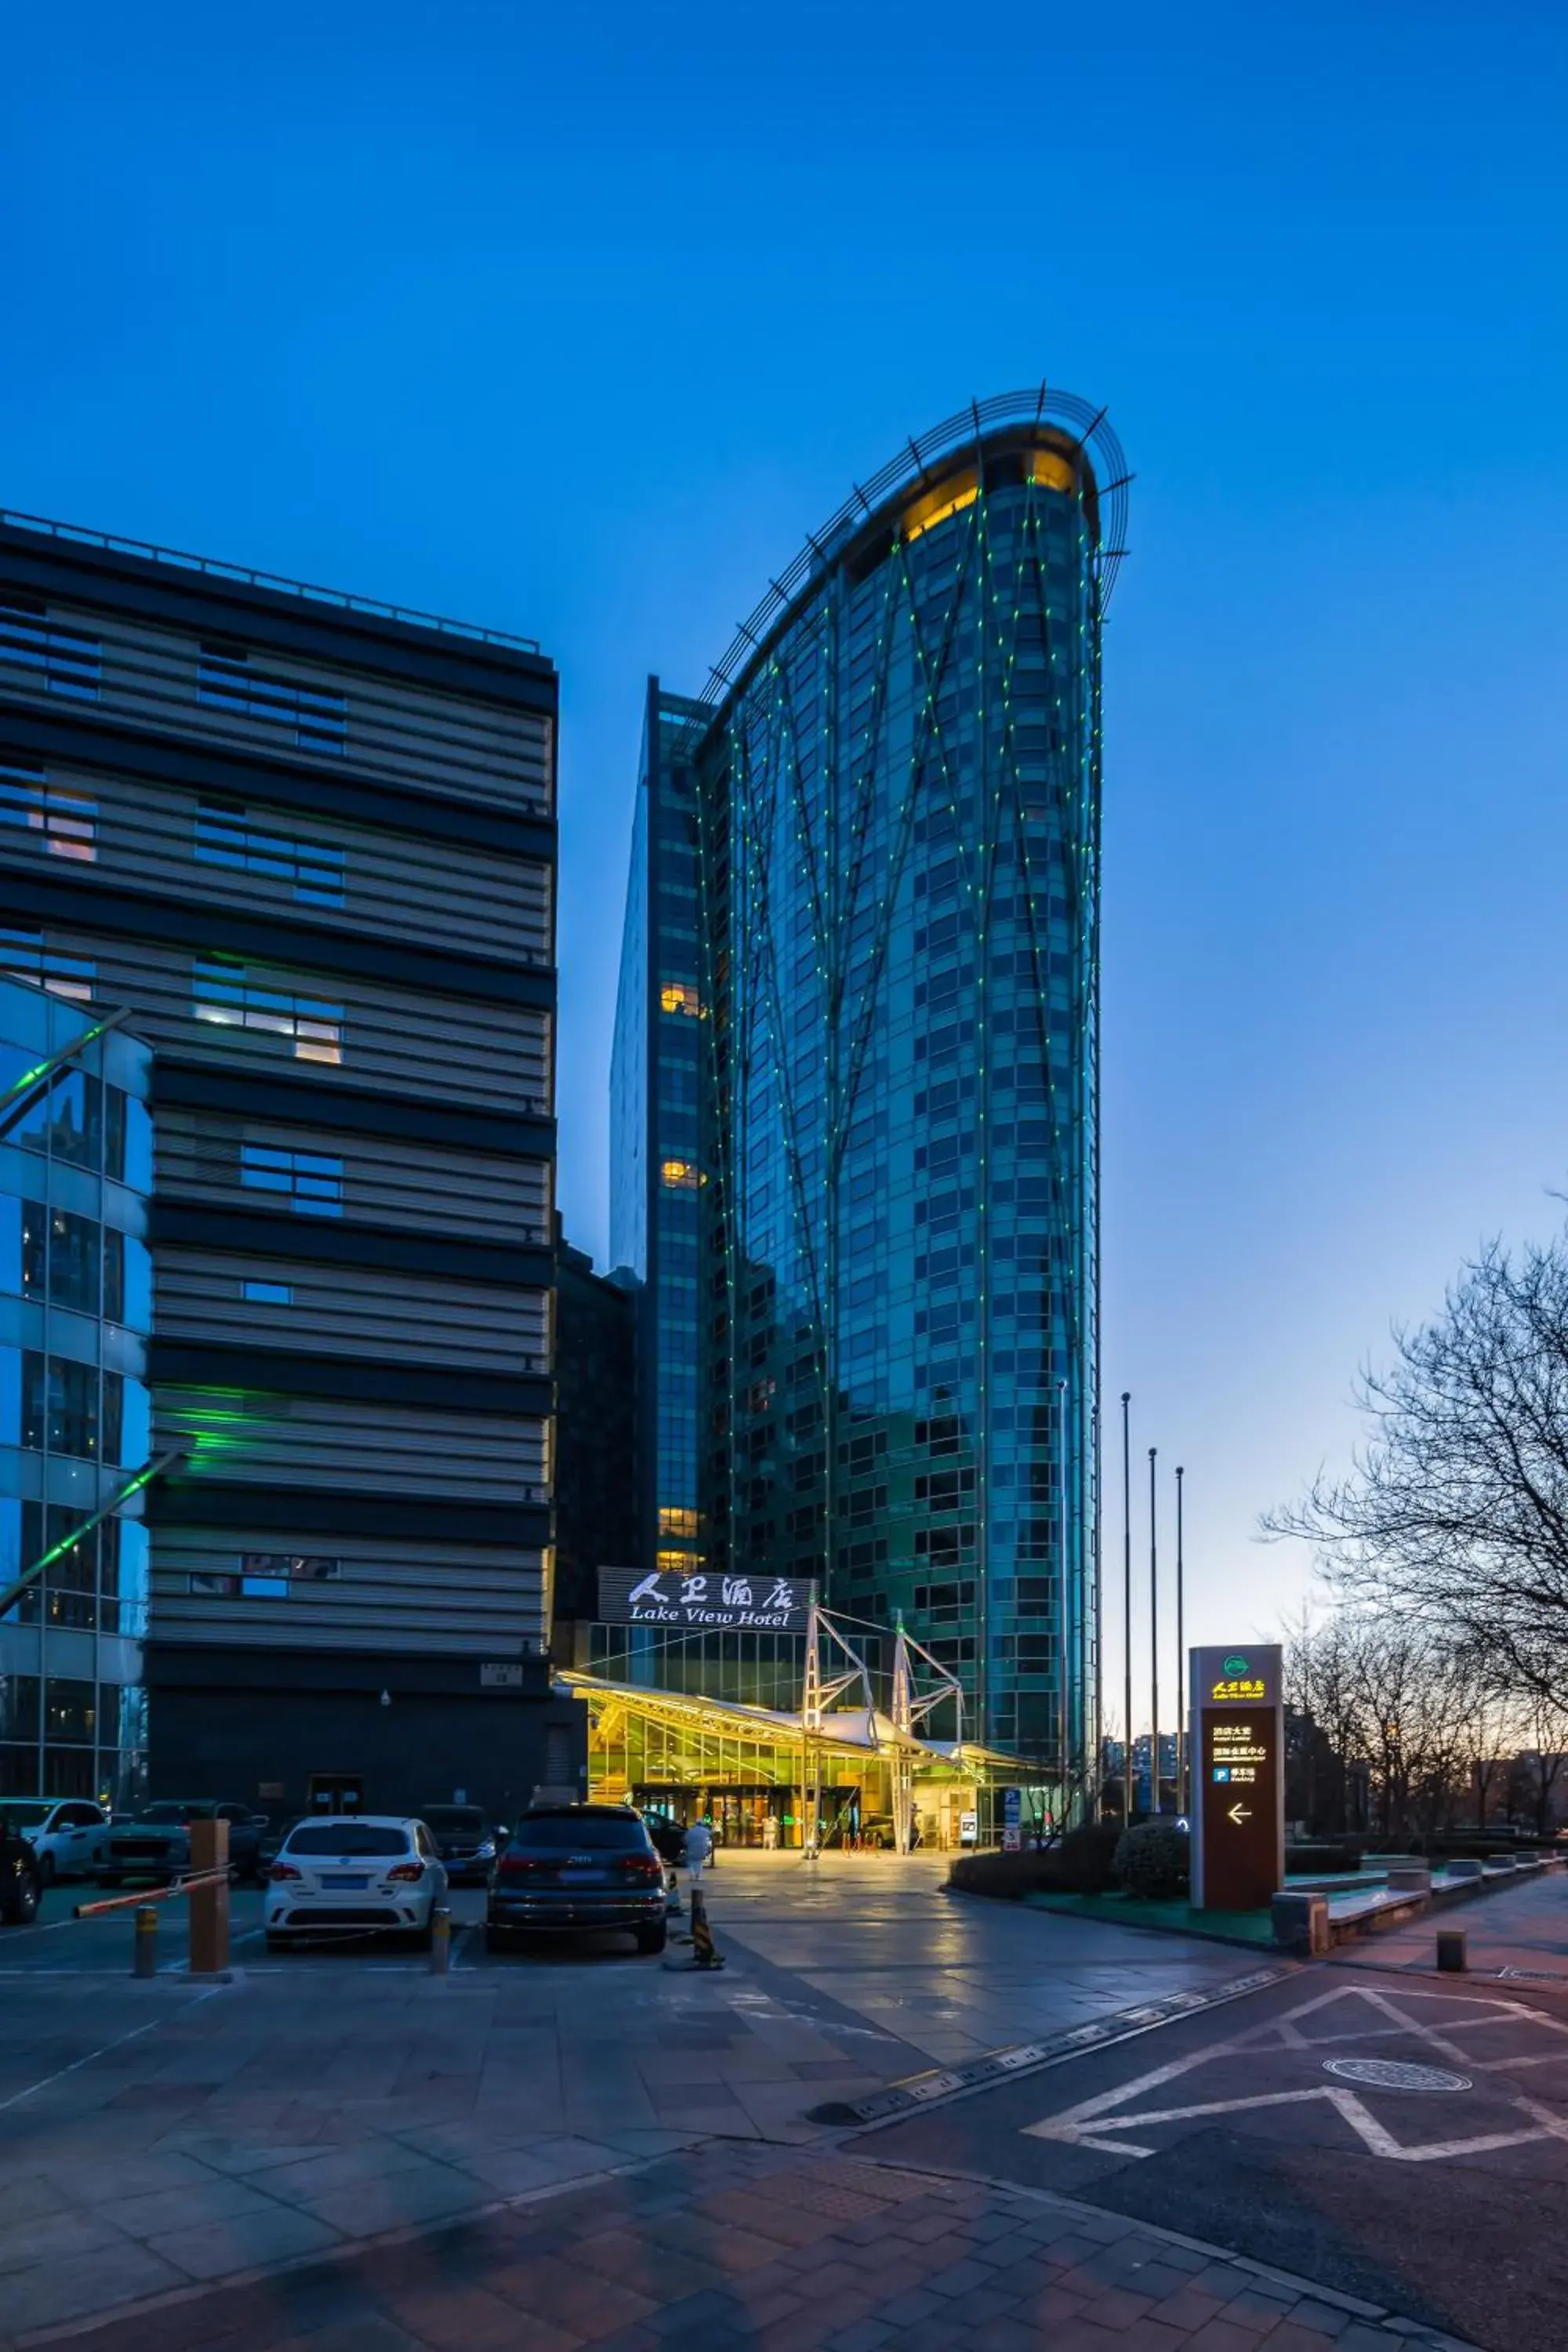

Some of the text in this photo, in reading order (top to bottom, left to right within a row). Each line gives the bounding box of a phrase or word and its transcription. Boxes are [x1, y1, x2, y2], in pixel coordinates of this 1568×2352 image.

[628, 1570, 793, 1608] 人卫酒店
[630, 1606, 789, 1627] Lake View Hotel
[1217, 1771, 1226, 1780] P
